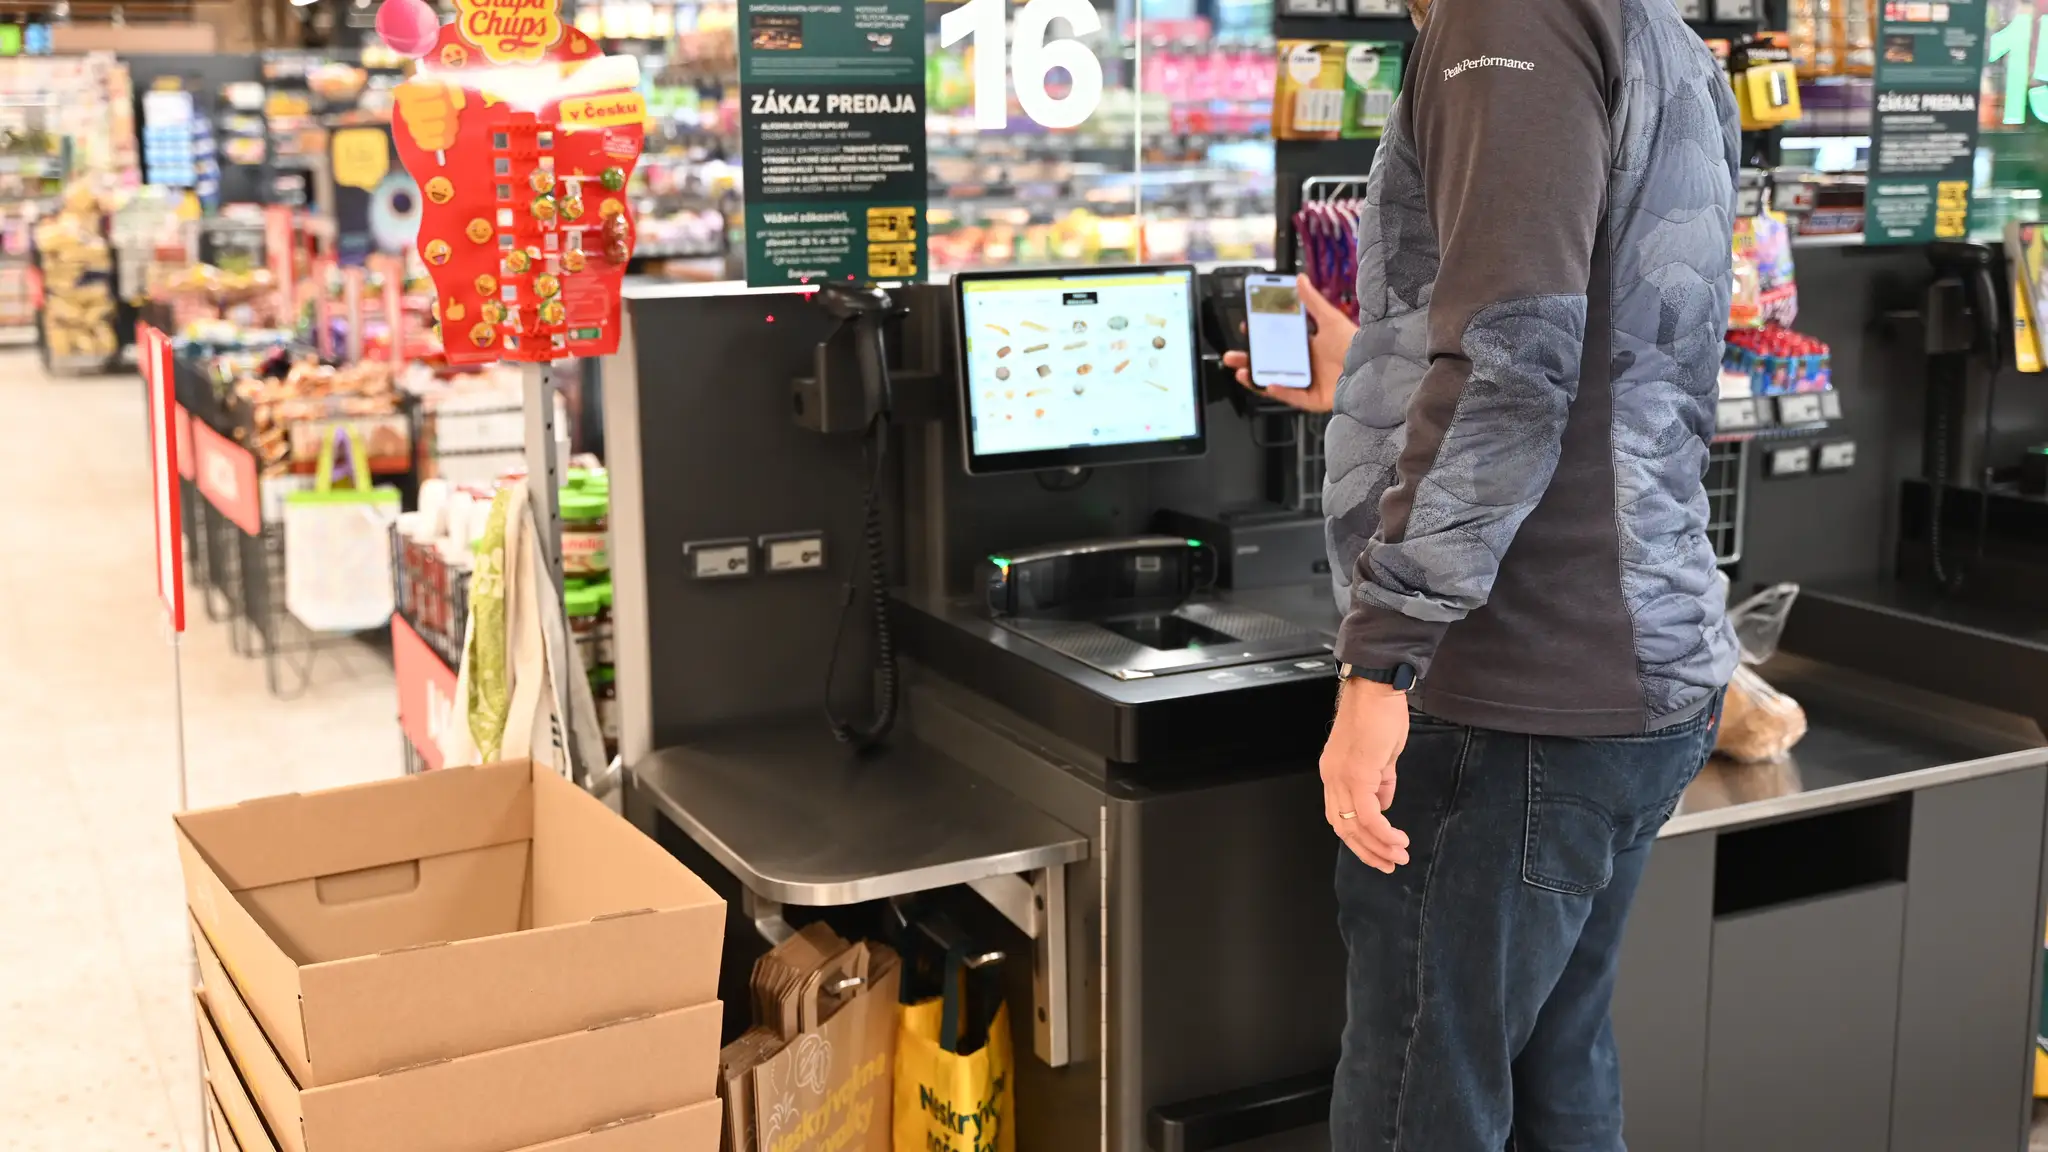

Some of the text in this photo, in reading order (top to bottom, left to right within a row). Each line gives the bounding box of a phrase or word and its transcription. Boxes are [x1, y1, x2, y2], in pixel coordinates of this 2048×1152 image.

[468, 10, 548, 52] Chups
[940, 0, 1104, 130] 16
[1443, 55, 1535, 81] PeakPerformance
[569, 102, 639, 120] v Česku
[751, 88, 917, 114] ZÁKAZ PREDAJA
